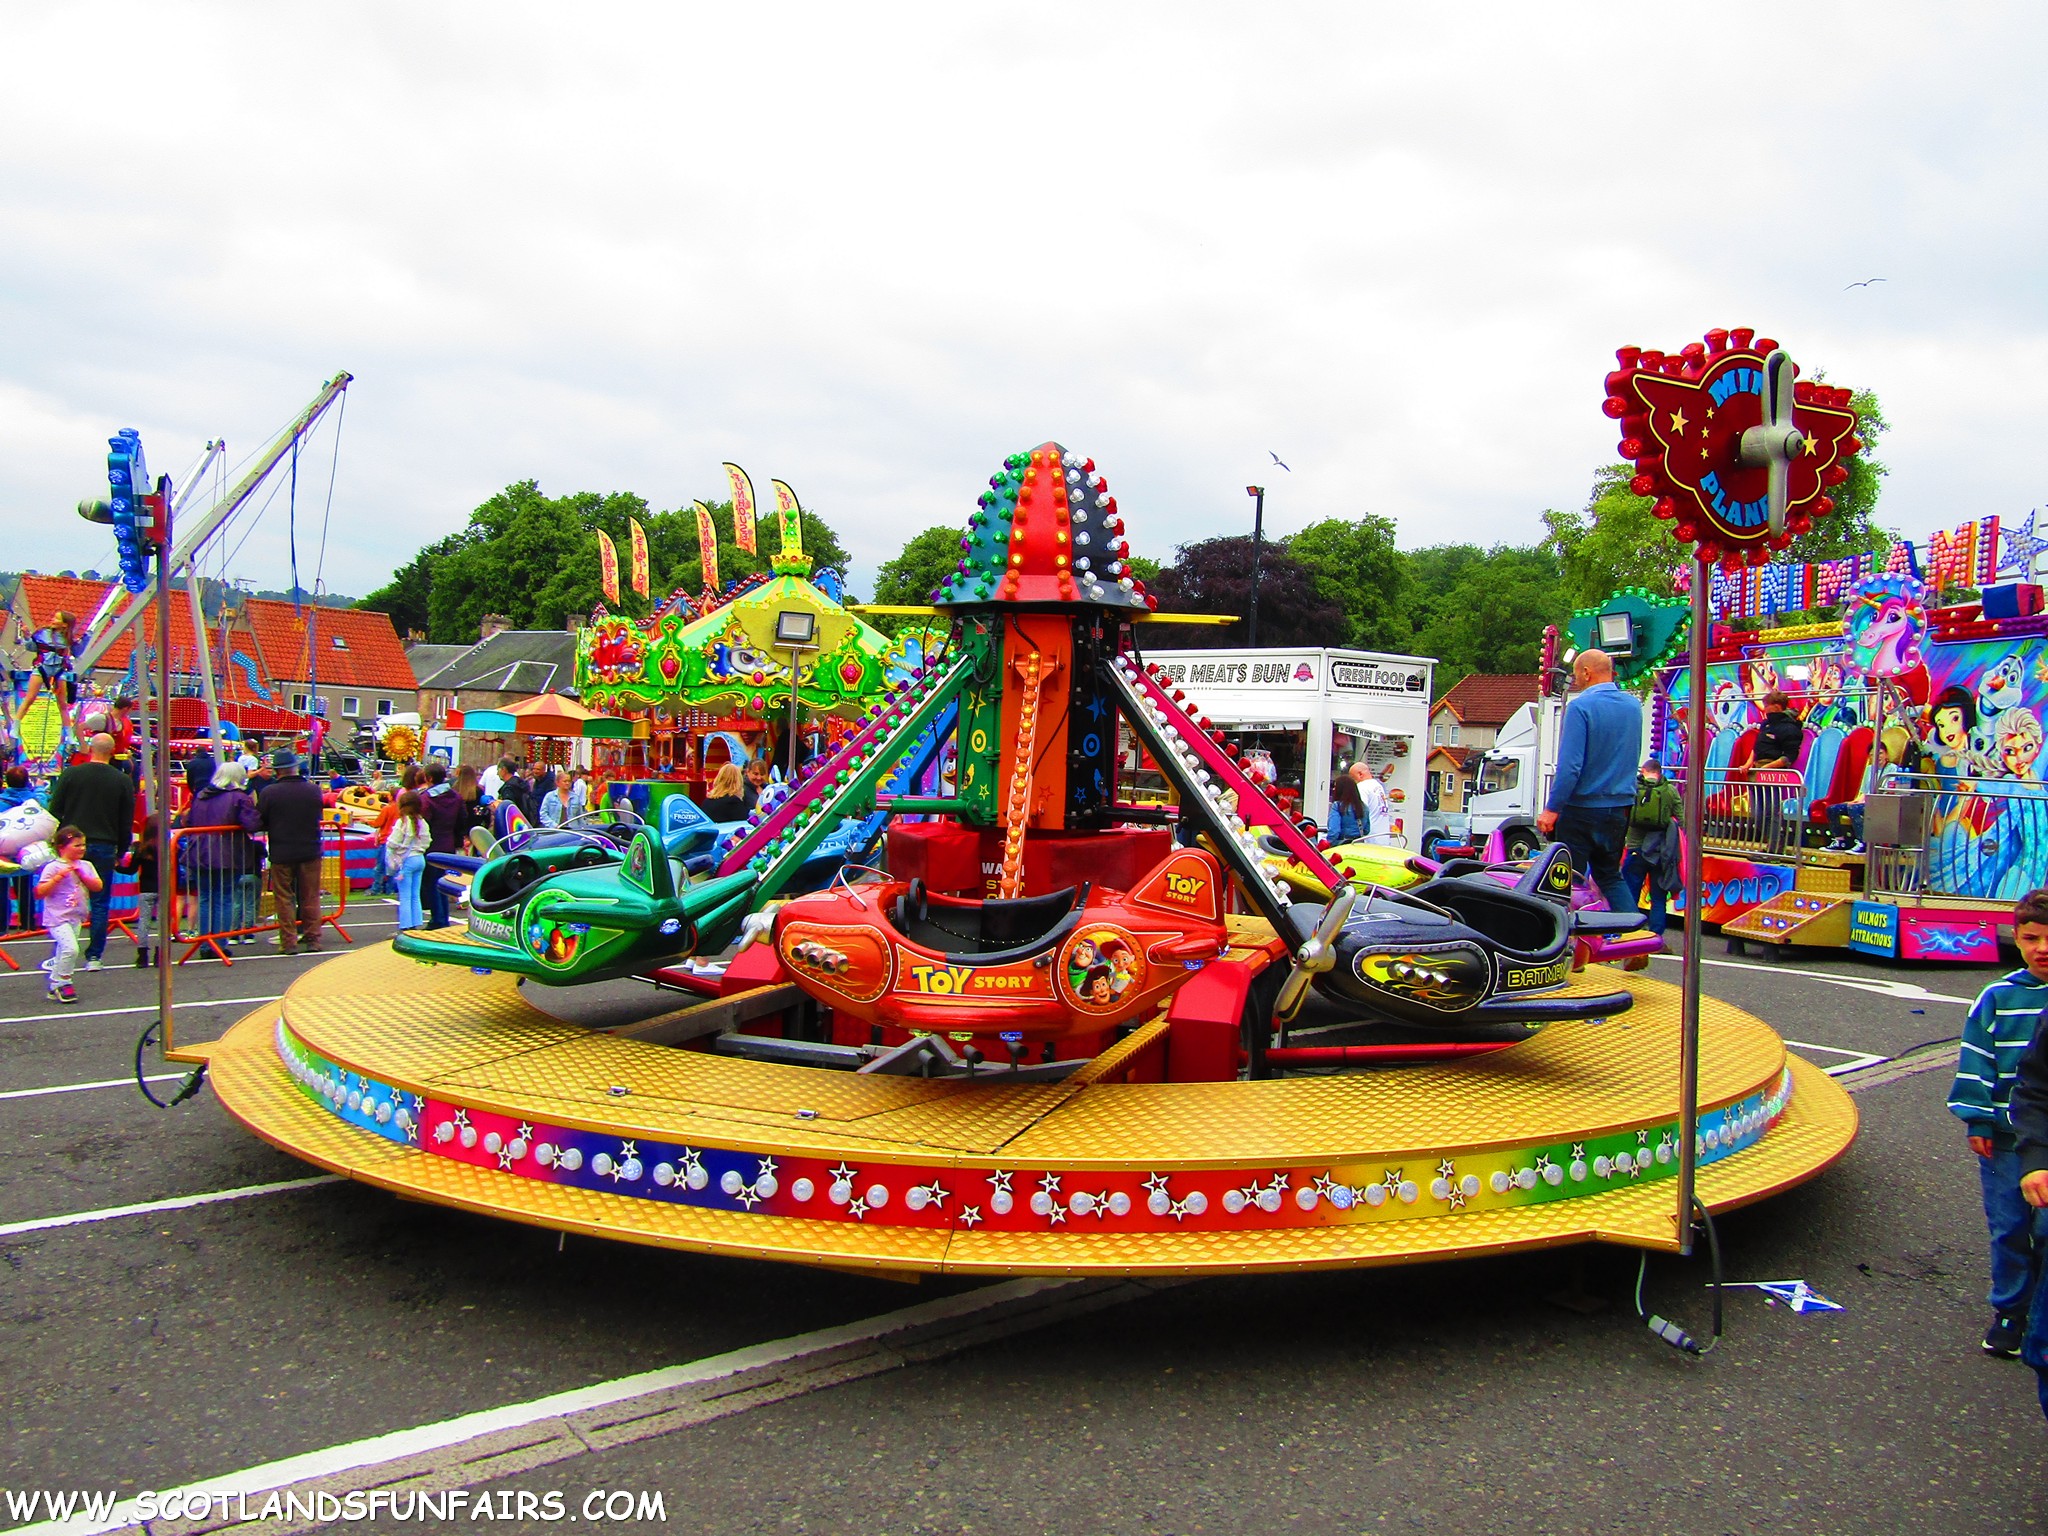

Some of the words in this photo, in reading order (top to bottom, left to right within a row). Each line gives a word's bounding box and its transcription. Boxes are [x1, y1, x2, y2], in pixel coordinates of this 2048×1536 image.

[1711, 562, 1807, 621] MINI
[1189, 662, 1248, 684] MEATS
[1251, 663, 1291, 684] BUN
[1337, 666, 1373, 684] FRESH
[1374, 668, 1406, 687] FOOD
[1344, 726, 1360, 735] CANDY
[1759, 773, 1776, 782] WAY
[1778, 773, 1788, 783] IN
[1166, 872, 1206, 895] TOY
[1165, 891, 1197, 904] STORY
[1857, 910, 1888, 927] WILMOTS
[1850, 927, 1893, 948] ATTRACTIONS
[911, 965, 975, 994] TOY
[974, 975, 1034, 989] STORY
[1507, 962, 1566, 987] BATMAN
